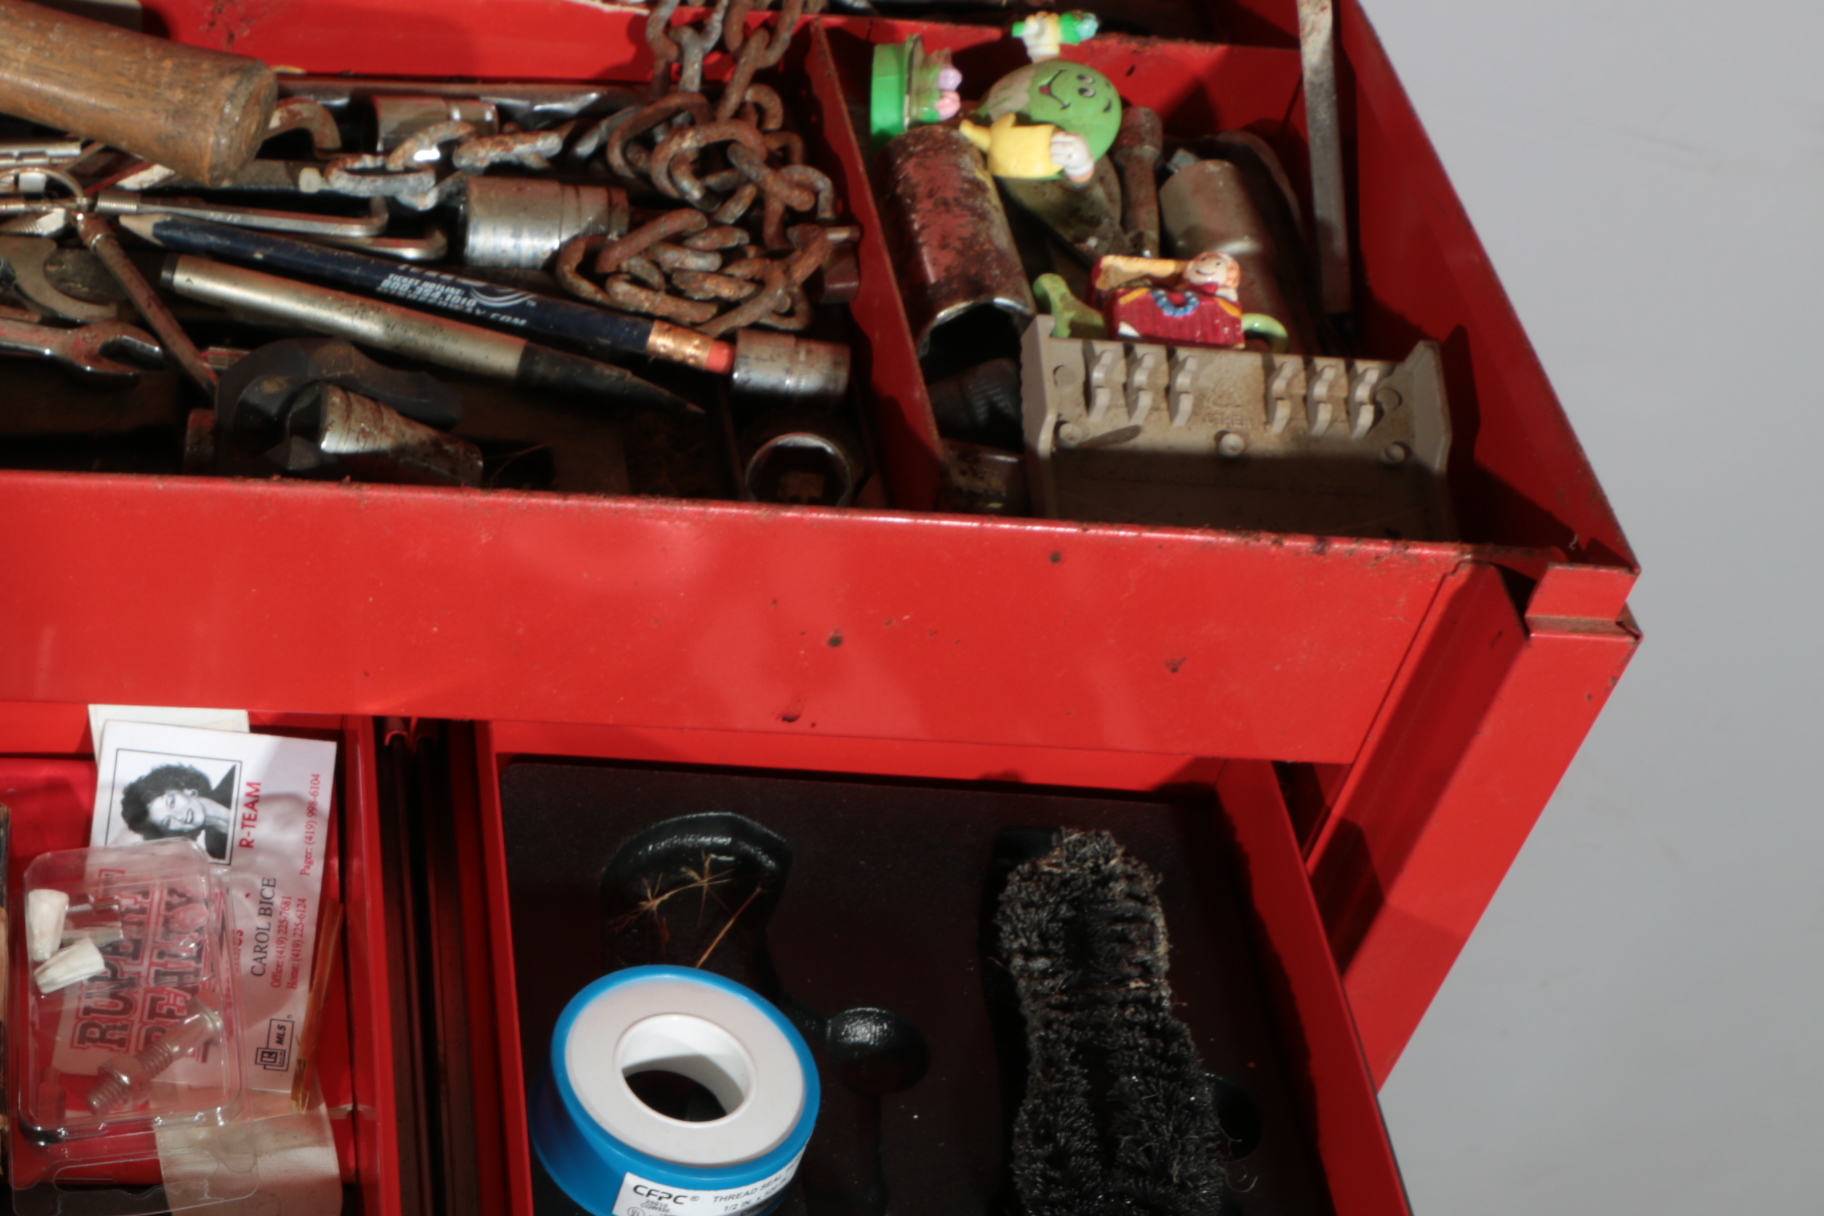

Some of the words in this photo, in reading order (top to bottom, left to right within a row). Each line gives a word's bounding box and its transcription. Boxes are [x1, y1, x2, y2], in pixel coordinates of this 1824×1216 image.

[307, 773, 322, 822] 998-6104
[238, 781, 262, 850] R-TEAM
[305, 822, 317, 848] (419)
[299, 850, 314, 877] Pager:
[258, 877, 277, 918] BICE
[279, 896, 293, 942] 225-7681
[294, 898, 308, 944] 225-6124
[250, 918, 273, 978] CAROL
[275, 941, 287, 962] (419)
[291, 944, 302, 966] (419)
[270, 961, 283, 990] Office:
[286, 966, 299, 990] Home:
[276, 1023, 287, 1046] MLS
[632, 1184, 689, 1205] CFPC
[712, 1186, 758, 1204] THREAD
[723, 1203, 739, 1213] 1/2
